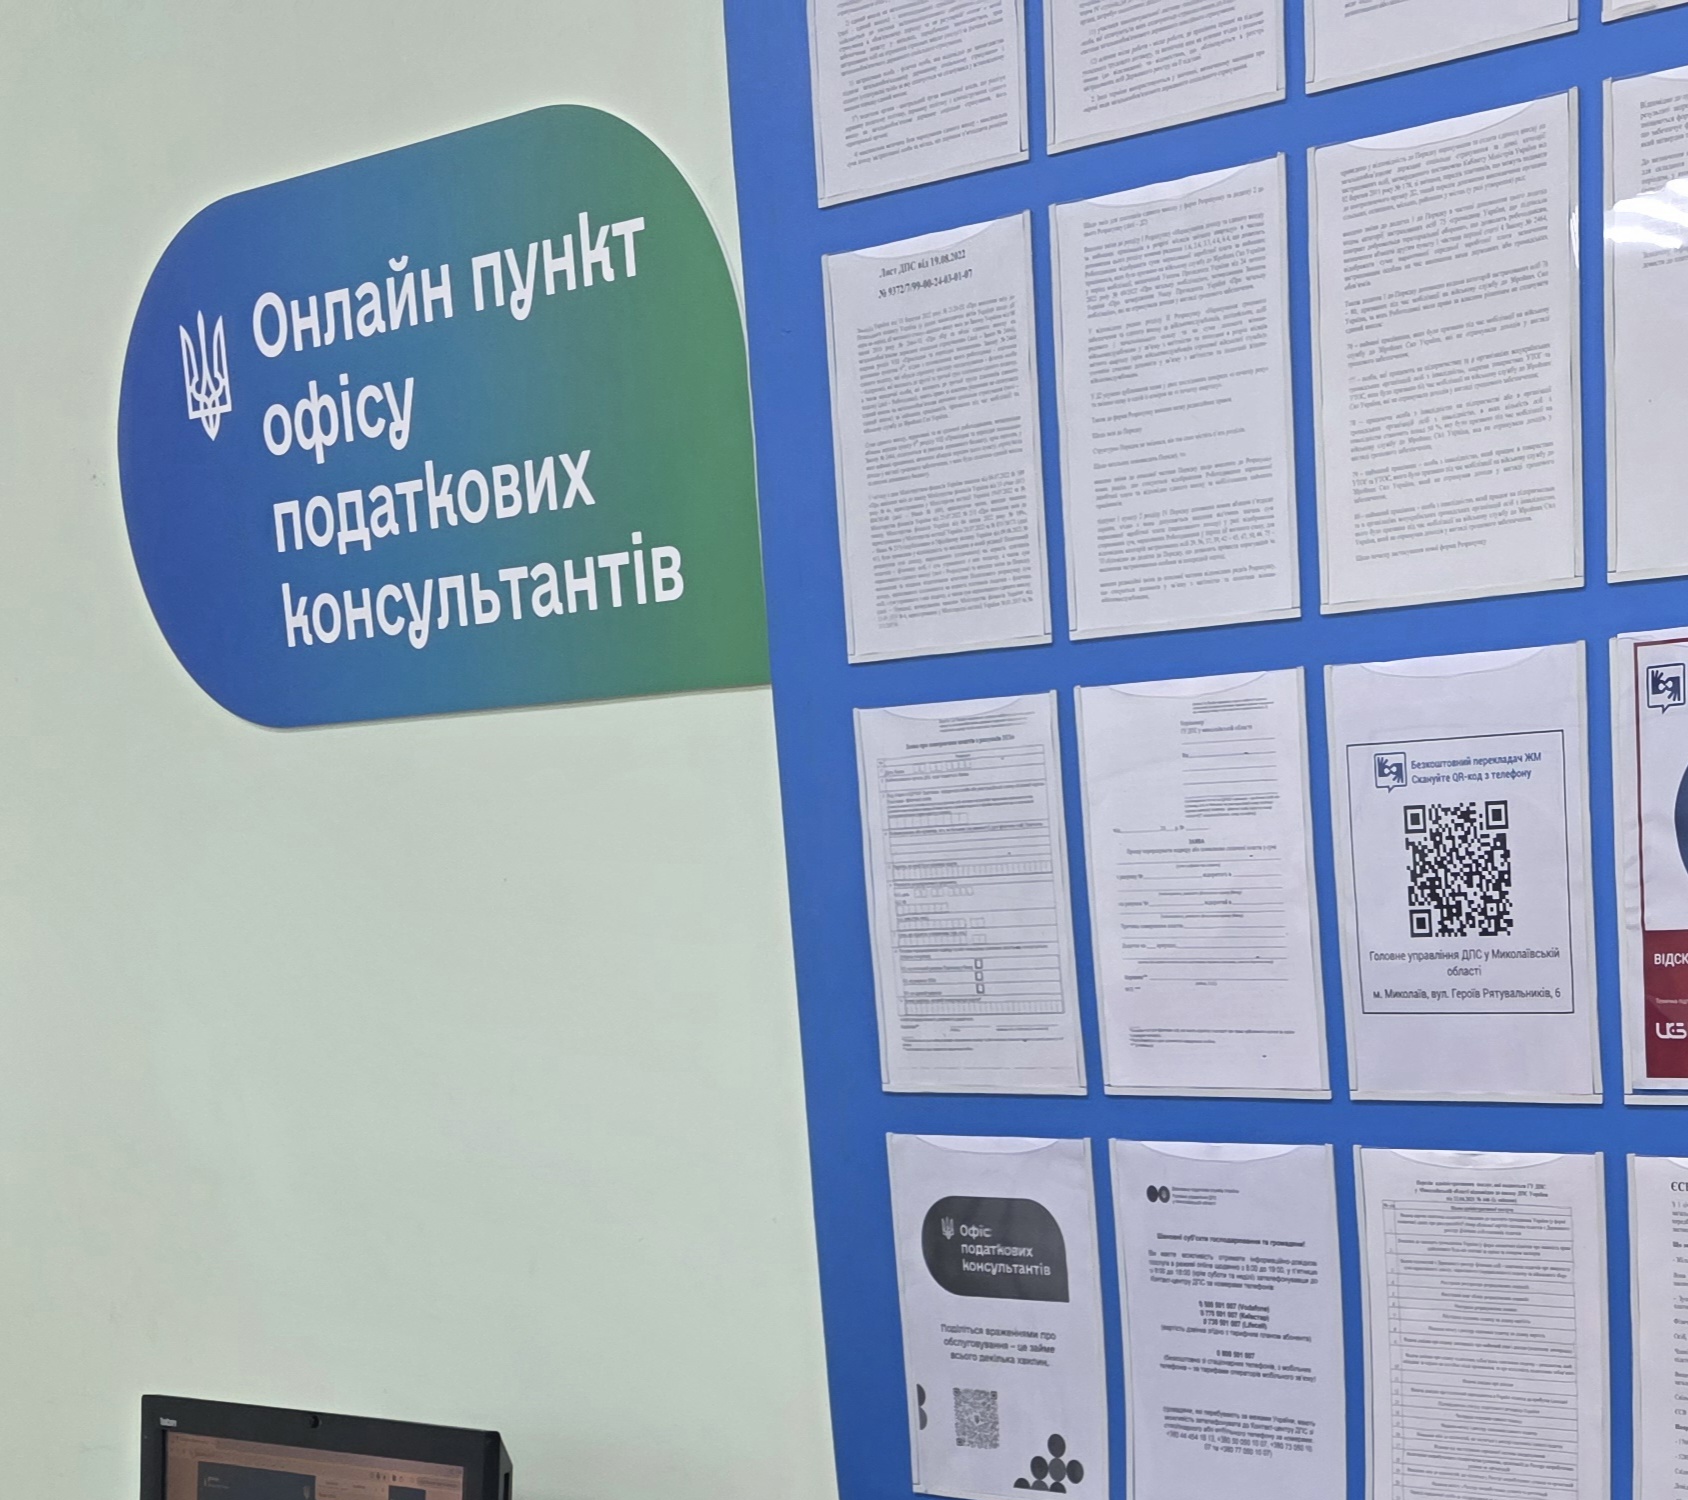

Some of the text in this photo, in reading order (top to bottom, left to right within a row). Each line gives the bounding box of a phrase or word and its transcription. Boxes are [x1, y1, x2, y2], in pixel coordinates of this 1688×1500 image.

[879, 249, 965, 278] Лист ДПС від 19.08.2022
[252, 211, 646, 358] Онлайн пункт
[878, 289, 887, 299] №
[262, 374, 414, 464] офісу
[272, 450, 595, 553] податкових
[282, 532, 685, 649] консультантів
[1411, 753, 1541, 769] Безкоштовний перекладач ЖМ
[1412, 773, 1450, 784] Скануйте
[1452, 772, 1483, 783] QR-код
[1491, 768, 1532, 780] телефону
[1369, 947, 1559, 962] Головне управління ДПС у Миколаївській
[1447, 966, 1482, 977] області
[1373, 987, 1560, 1000] м. Миколаїв, вул. Героїв Рятувальників, 6
[960, 1224, 992, 1239] Офіс
[961, 1244, 1033, 1257] податкових
[962, 1259, 1051, 1275] консультантів
[1040, 1331, 1056, 1340] про
